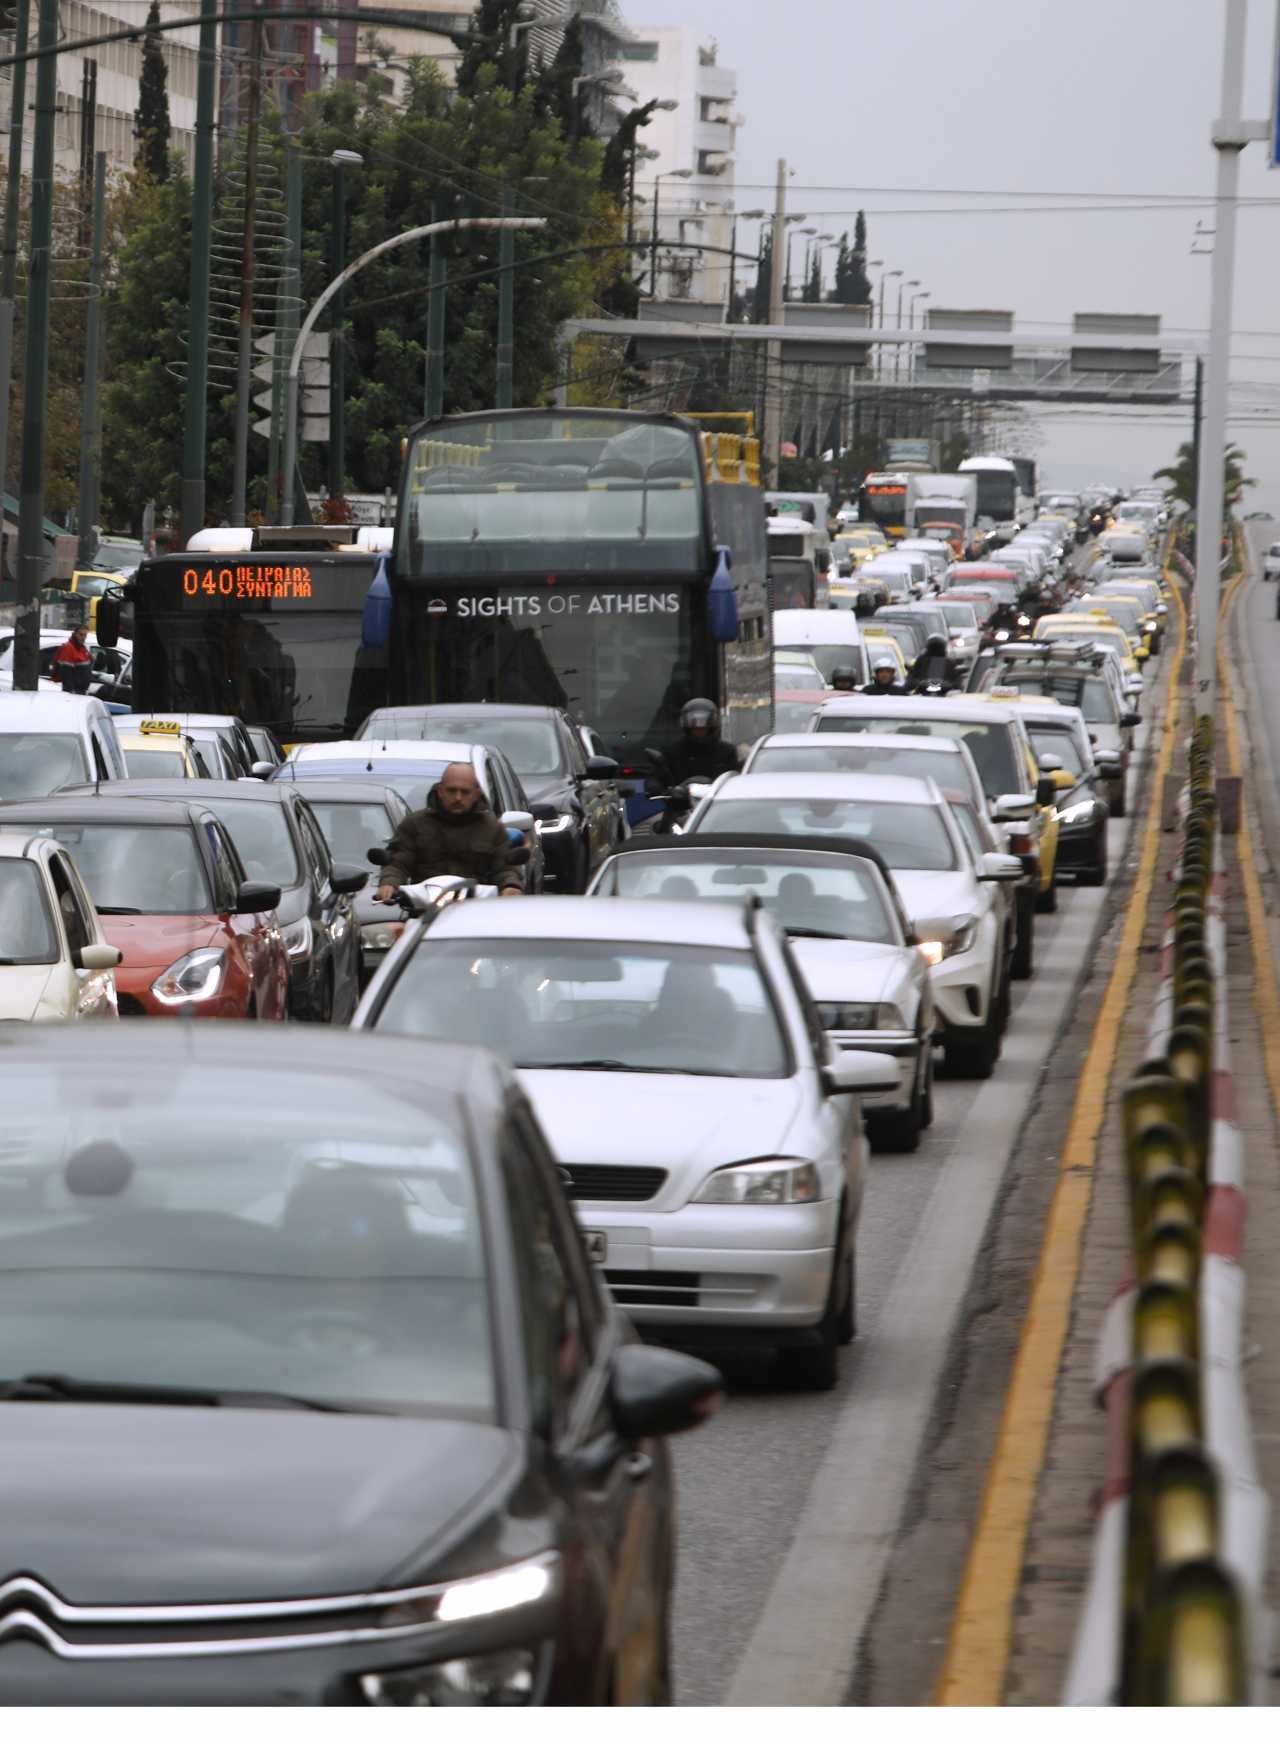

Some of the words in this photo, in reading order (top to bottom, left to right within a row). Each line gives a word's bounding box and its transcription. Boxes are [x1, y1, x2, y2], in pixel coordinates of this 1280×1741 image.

[183, 568, 233, 595] 040
[236, 581, 312, 598] ΣΥΝΤΑΓΜΑ
[457, 597, 541, 616] SIGHTS
[548, 595, 581, 614] OF
[587, 593, 680, 614] ATHENS
